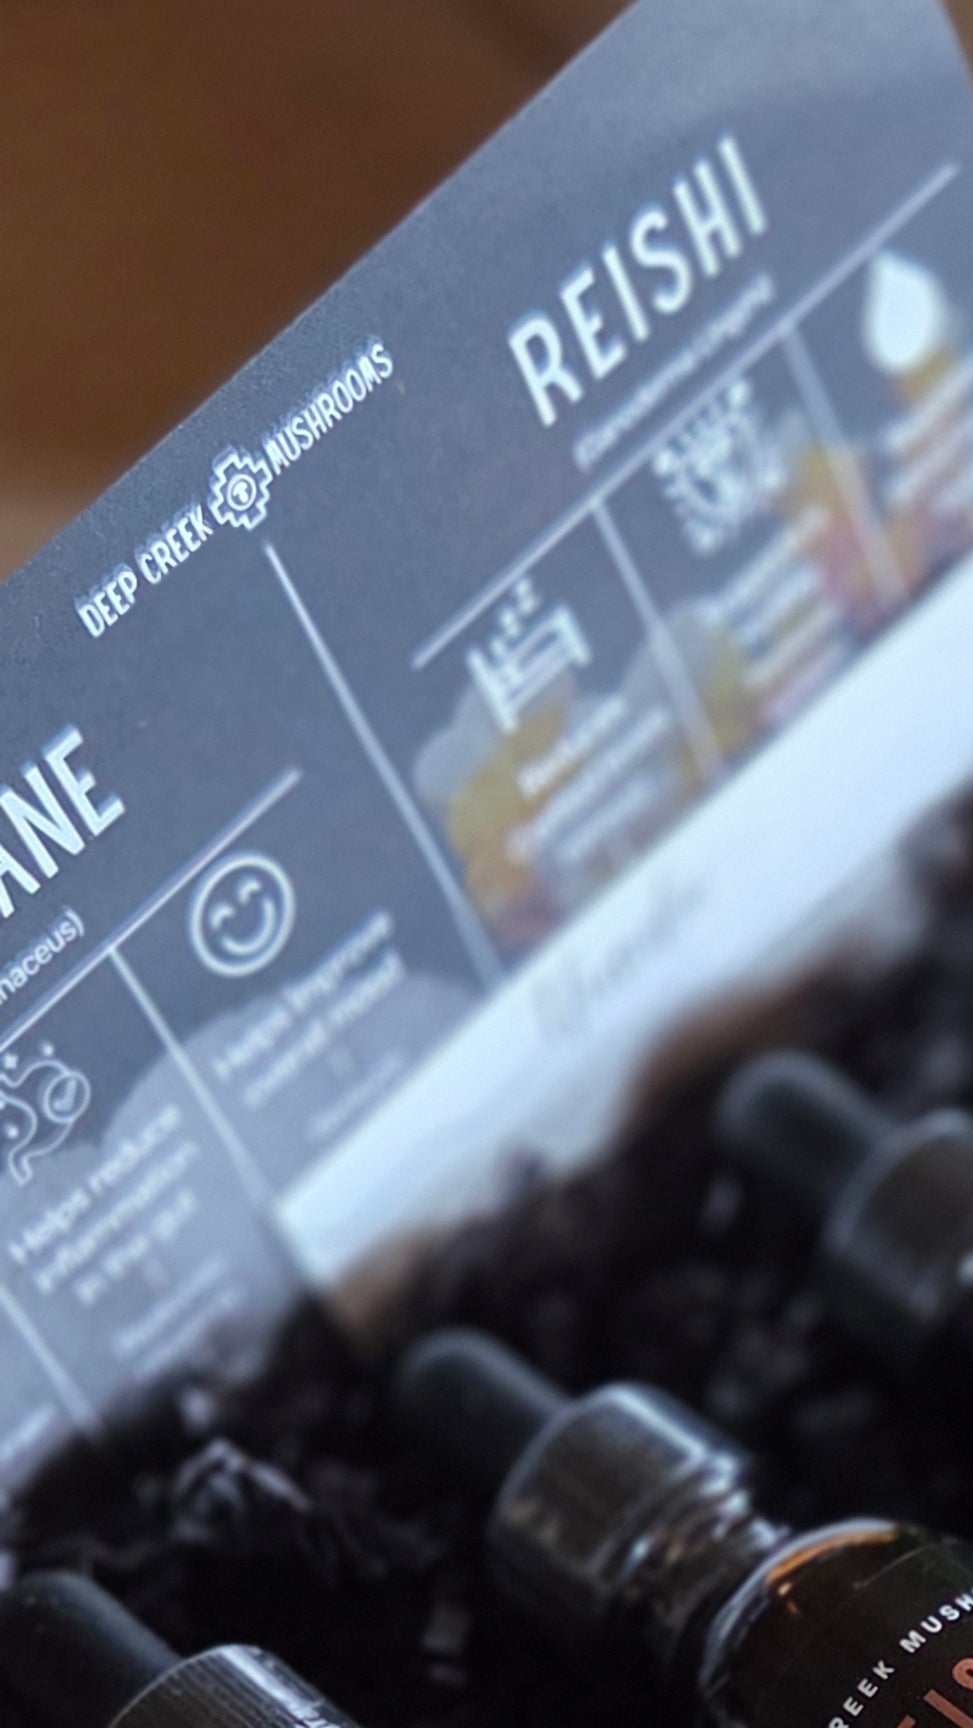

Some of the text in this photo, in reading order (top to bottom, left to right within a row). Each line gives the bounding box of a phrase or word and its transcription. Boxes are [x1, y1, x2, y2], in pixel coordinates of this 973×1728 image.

[507, 134, 766, 428] REISHI
[77, 340, 393, 638] DEEP CREEK MUSHROOMS
